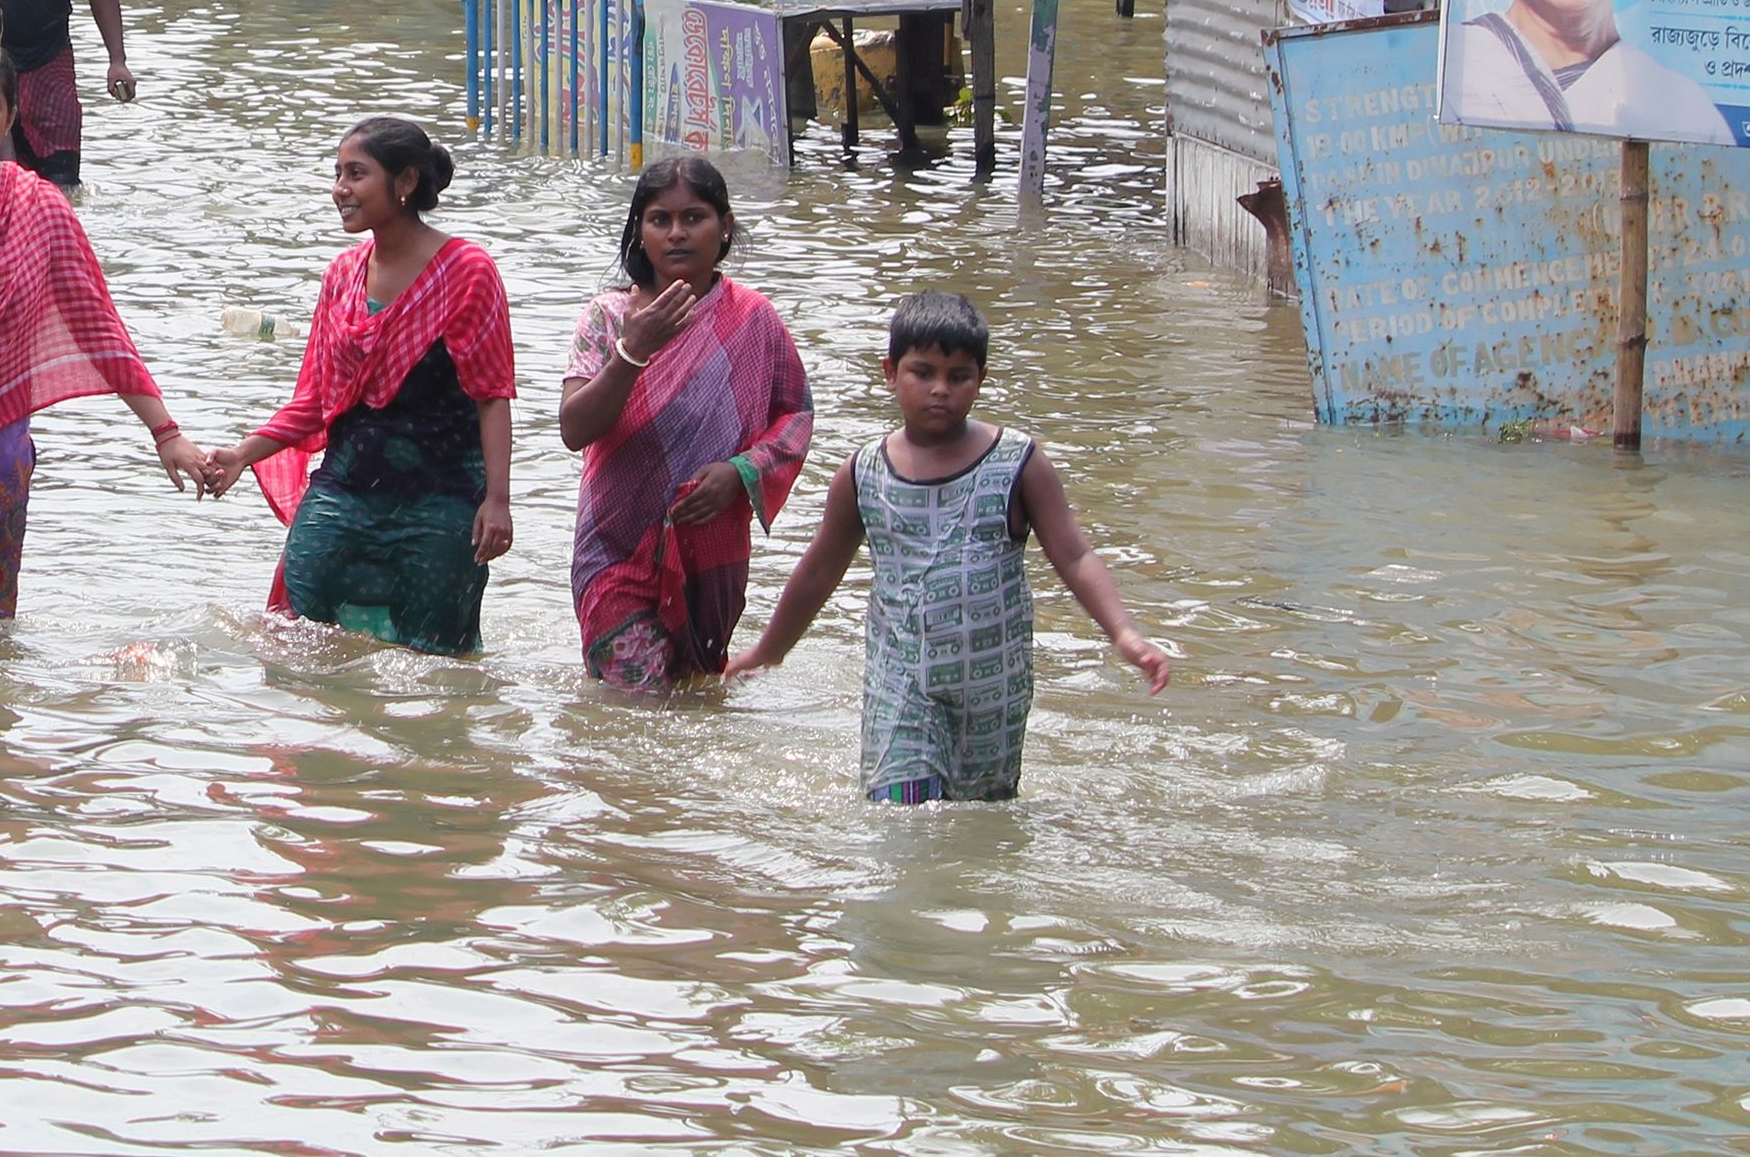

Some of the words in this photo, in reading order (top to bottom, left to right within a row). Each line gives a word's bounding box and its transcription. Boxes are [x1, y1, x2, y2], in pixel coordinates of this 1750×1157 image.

[1650, 25, 1720, 53] রাজ্যজুড়ে
[719, 26, 734, 90] দক্ষিণ
[1705, 60, 1716, 76] ও
[1305, 83, 1437, 123] STRENGT
[1384, 188, 1465, 219] YEAR
[1442, 250, 1621, 296] COMMENCEME
[1334, 312, 1434, 343] PERIOD
[1442, 305, 1476, 331] OF
[1430, 345, 1468, 379] OF
